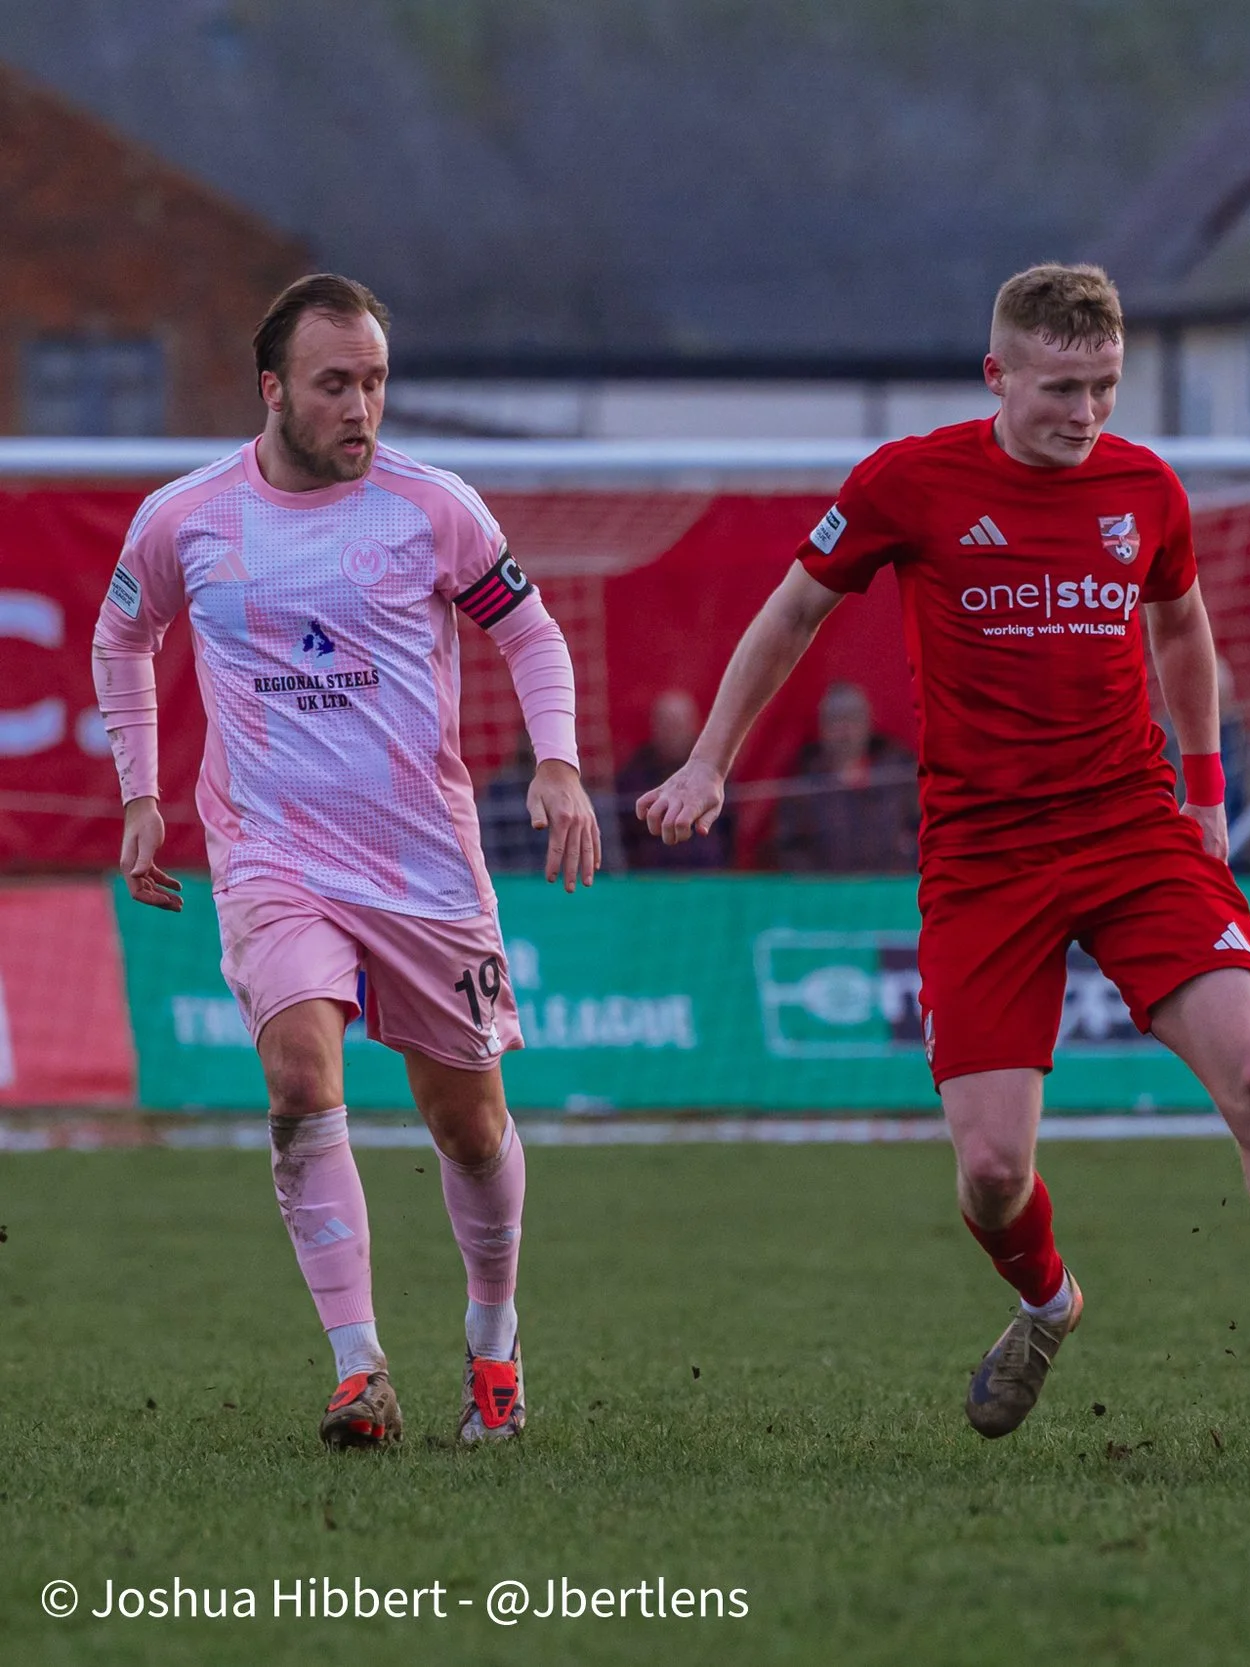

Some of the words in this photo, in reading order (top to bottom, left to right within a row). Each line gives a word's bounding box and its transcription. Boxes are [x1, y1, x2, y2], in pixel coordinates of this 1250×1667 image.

[983, 624, 1035, 637] working
[1037, 623, 1065, 635] with
[1068, 623, 1126, 637] WILSONS
[254, 674, 324, 693] REGIONAL
[326, 669, 380, 689] STEELS
[297, 694, 321, 711] UK
[455, 957, 500, 1031] 19
